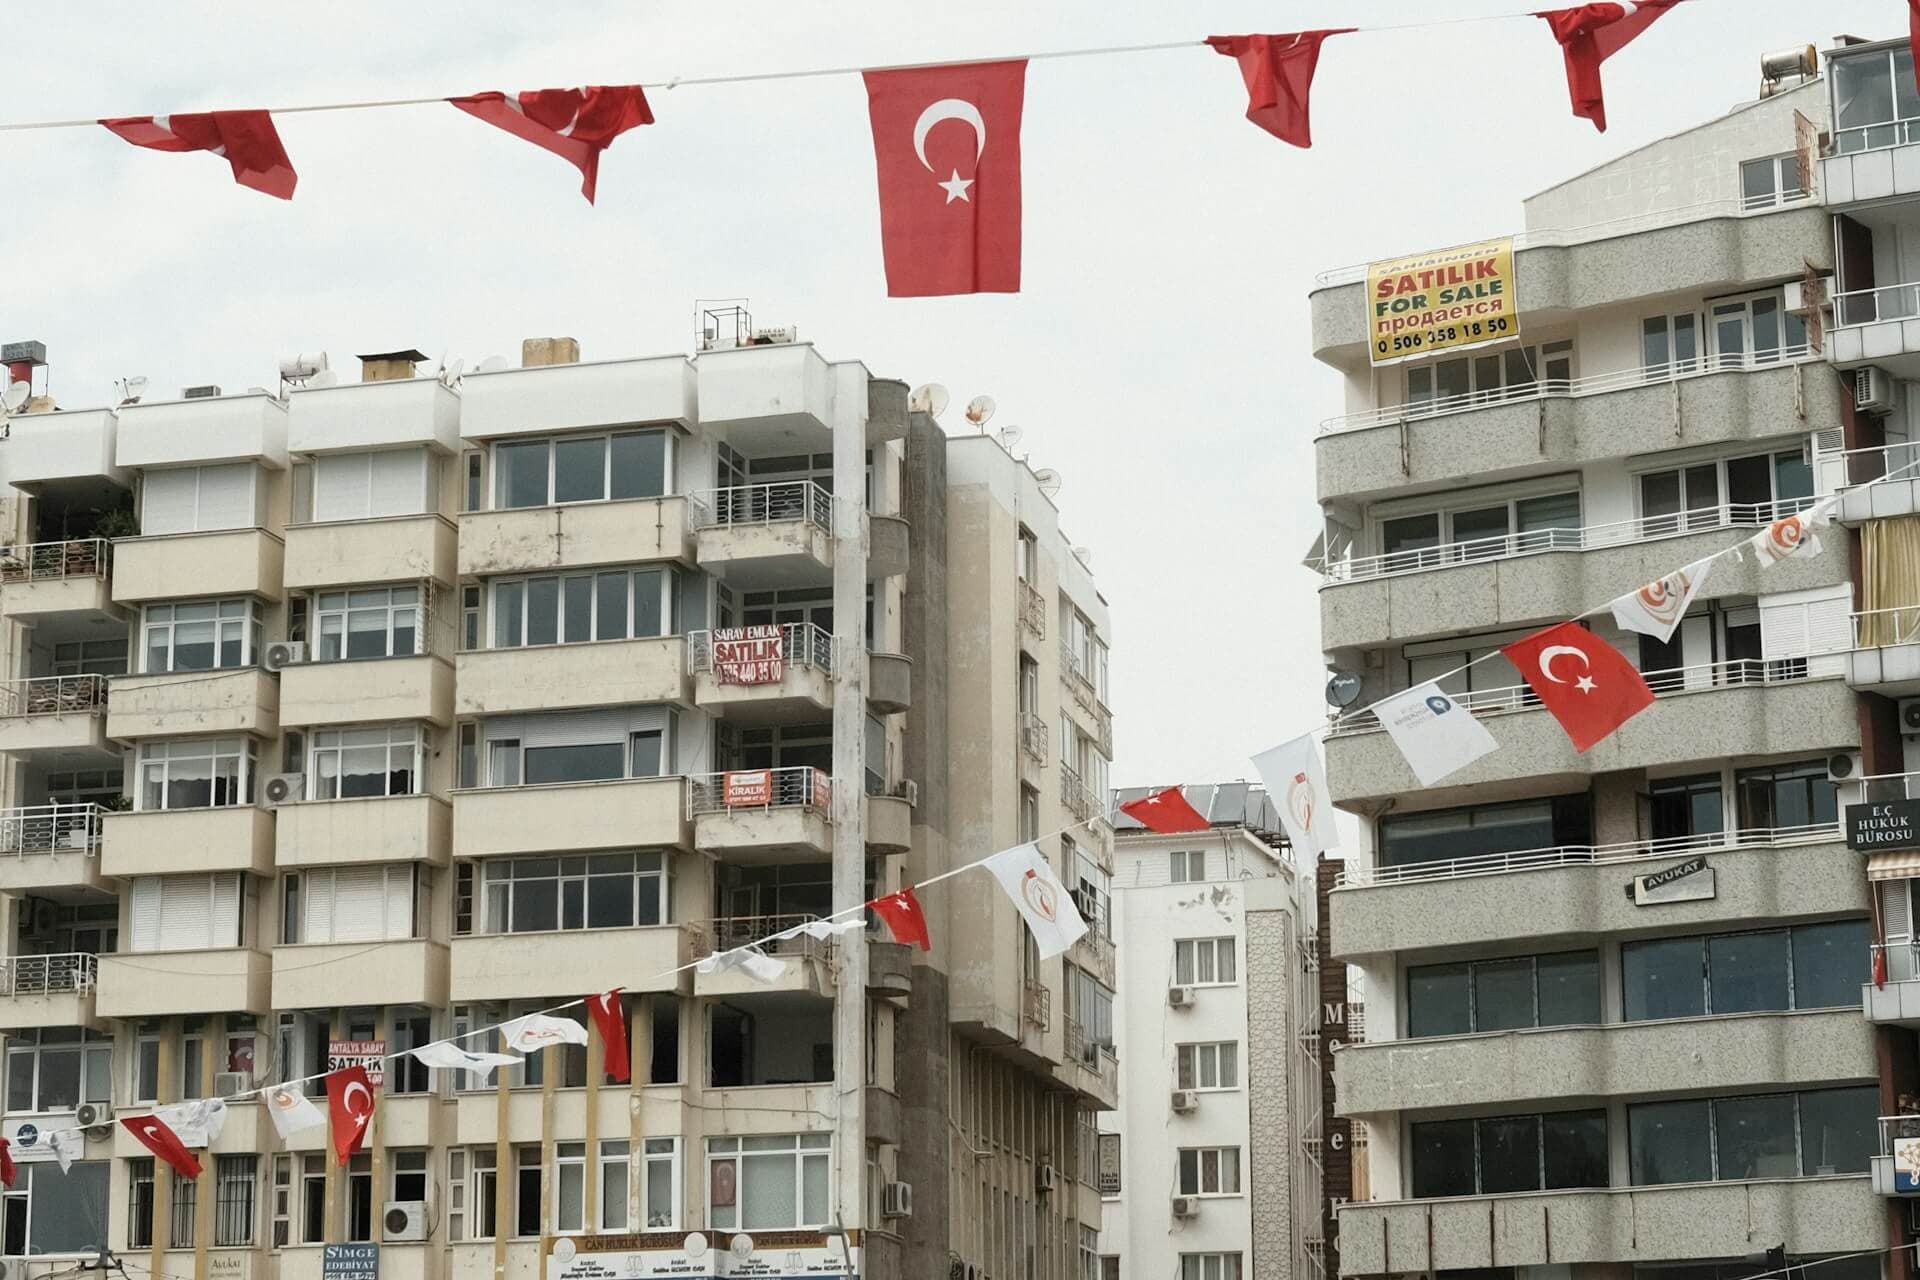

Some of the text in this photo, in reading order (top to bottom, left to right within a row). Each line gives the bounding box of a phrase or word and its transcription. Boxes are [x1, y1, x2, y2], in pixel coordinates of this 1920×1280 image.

[1377, 258, 1498, 298] SATILIK
[1376, 280, 1503, 316] FOR SALE
[1378, 299, 1503, 334] продается
[1378, 340, 1388, 353] 0
[1393, 333, 1422, 350] 506
[1464, 322, 1482, 337] 18
[1488, 318, 1508, 333] 50
[714, 624, 780, 641] SARAY EMLAK
[715, 640, 780, 662] SATILIK
[758, 661, 770, 680] 35
[770, 660, 782, 681] 00
[1858, 816, 1909, 830] HUKUK
[1648, 861, 1699, 887] AVUKAT
